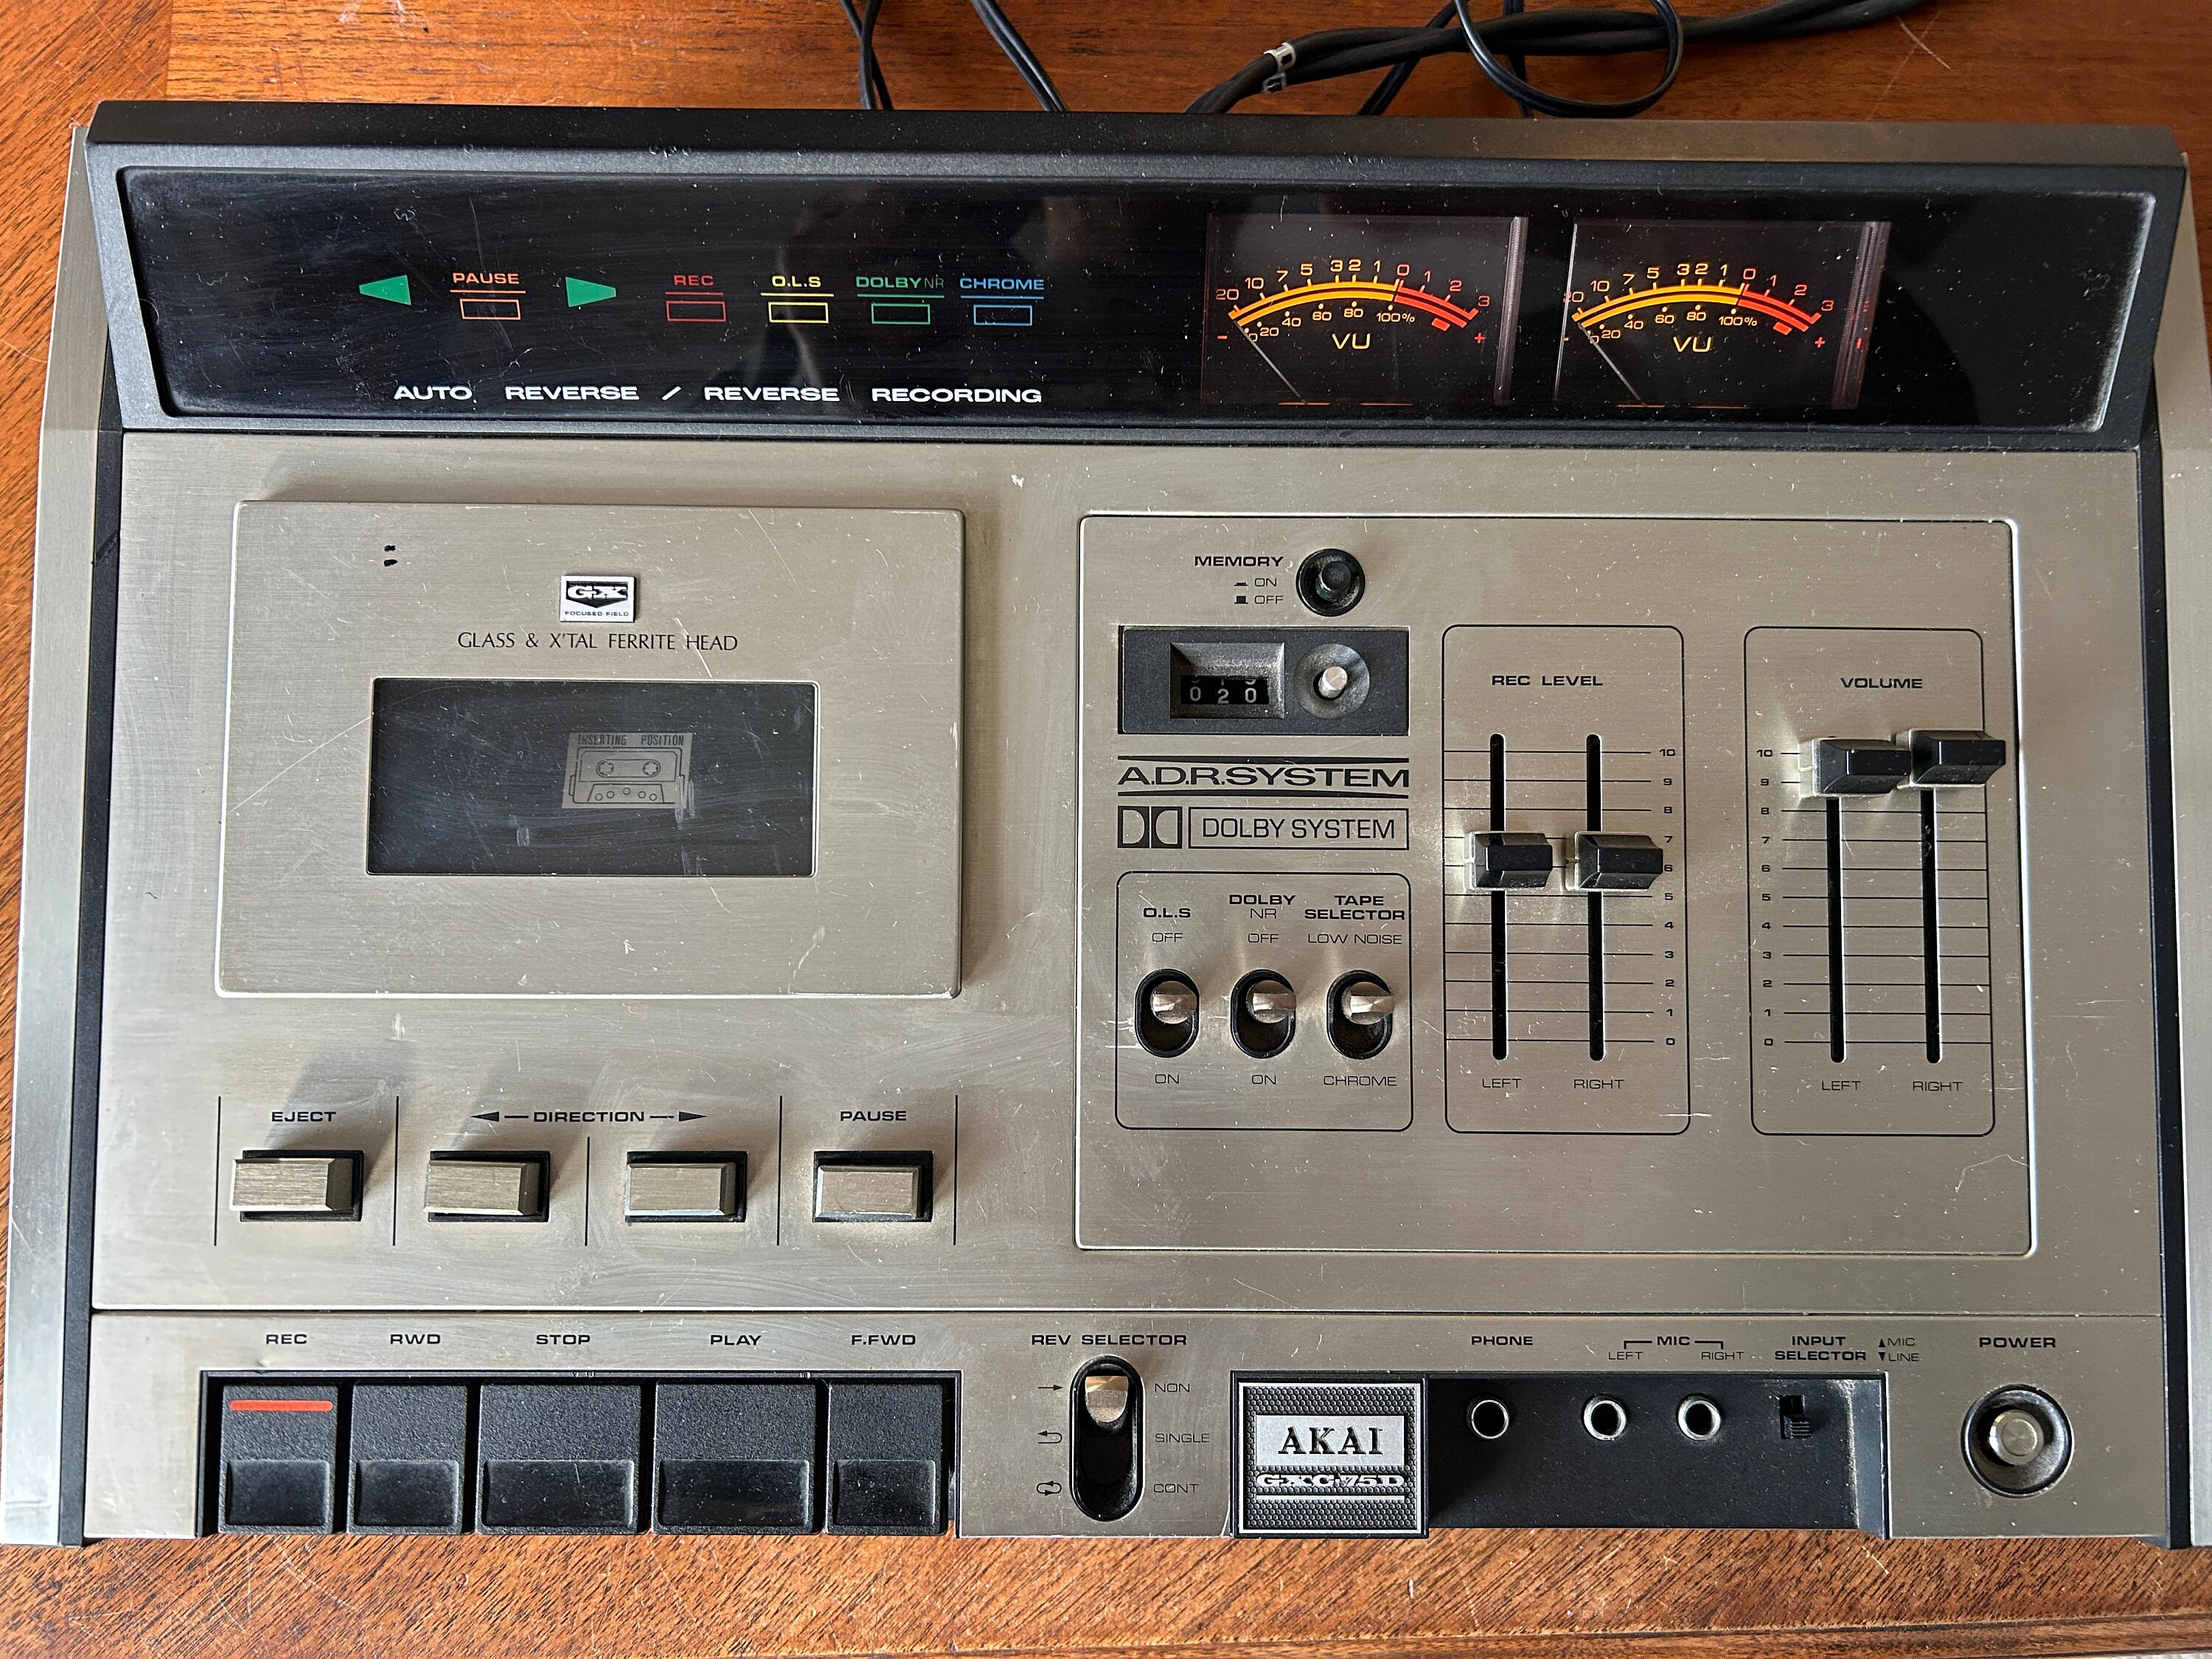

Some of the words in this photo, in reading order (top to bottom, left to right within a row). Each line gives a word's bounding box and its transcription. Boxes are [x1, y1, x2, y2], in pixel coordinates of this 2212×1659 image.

[1301, 263, 1312, 276] 5
[1331, 259, 1343, 271] 3
[1349, 259, 1361, 271] 2
[1374, 260, 1380, 271] 1
[1397, 264, 1409, 276] 0
[1677, 264, 1689, 276] 3
[1696, 264, 1708, 275] 2
[1647, 268, 1659, 279] 5
[1720, 265, 1728, 276] 1
[1744, 268, 1756, 279] 0
[453, 273, 519, 284] PAUSE
[674, 275, 713, 286] REC
[773, 276, 821, 287] O.L.S
[1276, 271, 1288, 282] 7
[1424, 271, 1430, 282] 1
[1623, 274, 1634, 285] 7
[1770, 275, 1777, 286] 1
[856, 276, 922, 288] DOLBY
[925, 277, 944, 288] NR
[960, 278, 1044, 290] CHROME
[1245, 277, 1264, 290] 10
[1450, 280, 1461, 291] 2
[1590, 281, 1610, 291] 10
[1216, 289, 1239, 300] 20
[1795, 285, 1806, 296] 2
[1478, 296, 1489, 306] 3
[1821, 301, 1833, 310] 3
[1312, 312, 1332, 321] 60
[1344, 307, 1363, 318] 80
[1377, 313, 1415, 322] 100%
[1686, 312, 1706, 321] 80
[1282, 318, 1301, 327] 40
[1655, 315, 1674, 324] 60
[1718, 317, 1757, 326] 100%
[1624, 321, 1644, 330] 40
[1260, 327, 1279, 336] 20
[1601, 330, 1621, 338] 20
[1248, 333, 1257, 341] 0
[1332, 333, 1370, 349] VU
[1673, 336, 1711, 352] VU
[394, 386, 472, 400] AUTO
[506, 386, 639, 400] REVERSE
[705, 387, 840, 402] REVERSE
[872, 389, 1041, 403] RECORDING
[1194, 556, 1284, 566] MEMORY
[1255, 578, 1277, 587] ON
[568, 586, 627, 599] GX
[1254, 596, 1284, 604] OFF
[458, 633, 515, 649] GLASS
[526, 633, 538, 647] &
[549, 633, 597, 649] X'TAL
[609, 634, 675, 650] FERRITE
[687, 636, 737, 651] HEAD
[1492, 675, 1530, 686] REC
[1542, 676, 1603, 686] LEVEL
[1840, 678, 1922, 689] VOLUME
[578, 734, 626, 745] INSERTING
[641, 735, 684, 745] POSITION
[1663, 778, 1672, 786] 9
[1203, 818, 1285, 838] DOLBY
[1292, 819, 1394, 838] SYSTEM
[1229, 894, 1296, 905] DOLBY
[1335, 895, 1383, 905] TAPE
[1143, 908, 1191, 918] O.L.S
[1251, 909, 1276, 919] NR
[1304, 909, 1405, 919] SELECTOR
[1152, 933, 1183, 942] OFF
[1248, 933, 1279, 943] OFF
[1308, 933, 1348, 943] LOW
[1354, 934, 1402, 944] NOISE
[1155, 1074, 1179, 1084] ON
[1252, 1075, 1276, 1085] ON
[1324, 1076, 1397, 1085] CHROME
[1482, 1079, 1521, 1088] LEFT
[1574, 1079, 1624, 1089] RIGHT
[1822, 1081, 1861, 1091] LEFT
[1913, 1082, 1962, 1091] RIGHT
[271, 1112, 336, 1122] EJECT
[534, 1112, 644, 1122] DIRECTION
[841, 1111, 907, 1121] PAUSE
[266, 1334, 307, 1344] REC
[390, 1334, 441, 1344] RWD
[536, 1335, 591, 1345] STOP
[710, 1335, 762, 1346] PLAY
[852, 1335, 916, 1345] F.FWD
[1032, 1335, 1071, 1345] REV
[1082, 1335, 1186, 1345] SELECTOR
[1472, 1336, 1533, 1346] PHONE
[1657, 1336, 1690, 1346] MIC
[1792, 1337, 1846, 1346] INPUT
[1888, 1338, 1915, 1346] MIC
[1979, 1338, 2056, 1348] POWER
[1608, 1352, 1643, 1360] LEFT
[1702, 1352, 1745, 1360] RIGHT
[1775, 1351, 1866, 1360] SELECTOR
[1889, 1353, 1919, 1362] LINE
[1155, 1383, 1190, 1392] NON
[1155, 1434, 1210, 1442] SINGLE
[1278, 1426, 1382, 1455] AKAI
[1154, 1484, 1198, 1492] CONT
